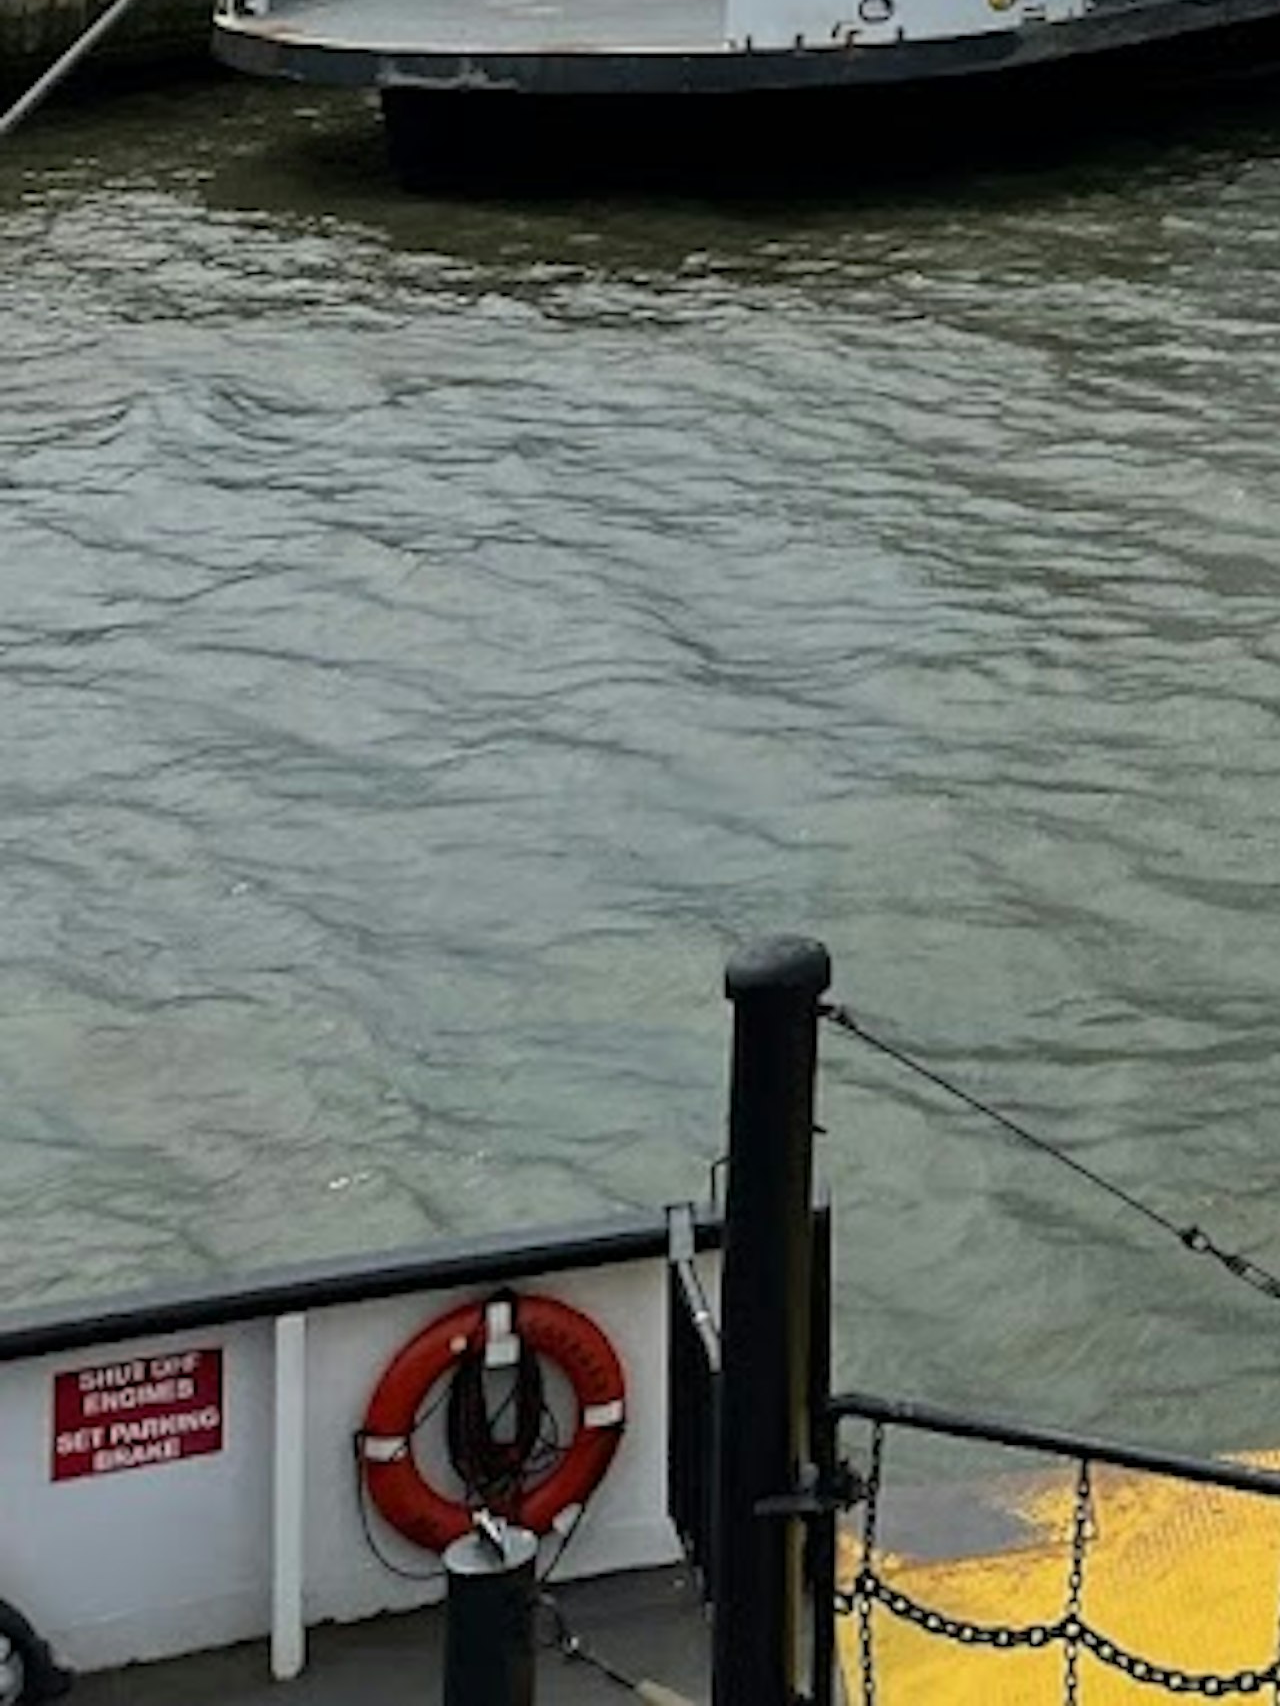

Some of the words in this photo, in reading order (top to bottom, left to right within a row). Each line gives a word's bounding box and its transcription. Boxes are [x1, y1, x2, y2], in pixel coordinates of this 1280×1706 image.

[78, 1359, 146, 1391] SHUT
[150, 1351, 202, 1379] OFF
[82, 1377, 195, 1417] ENGINES
[56, 1426, 105, 1455] SET
[110, 1404, 220, 1444] PARKING
[92, 1436, 181, 1471] BRAKE
